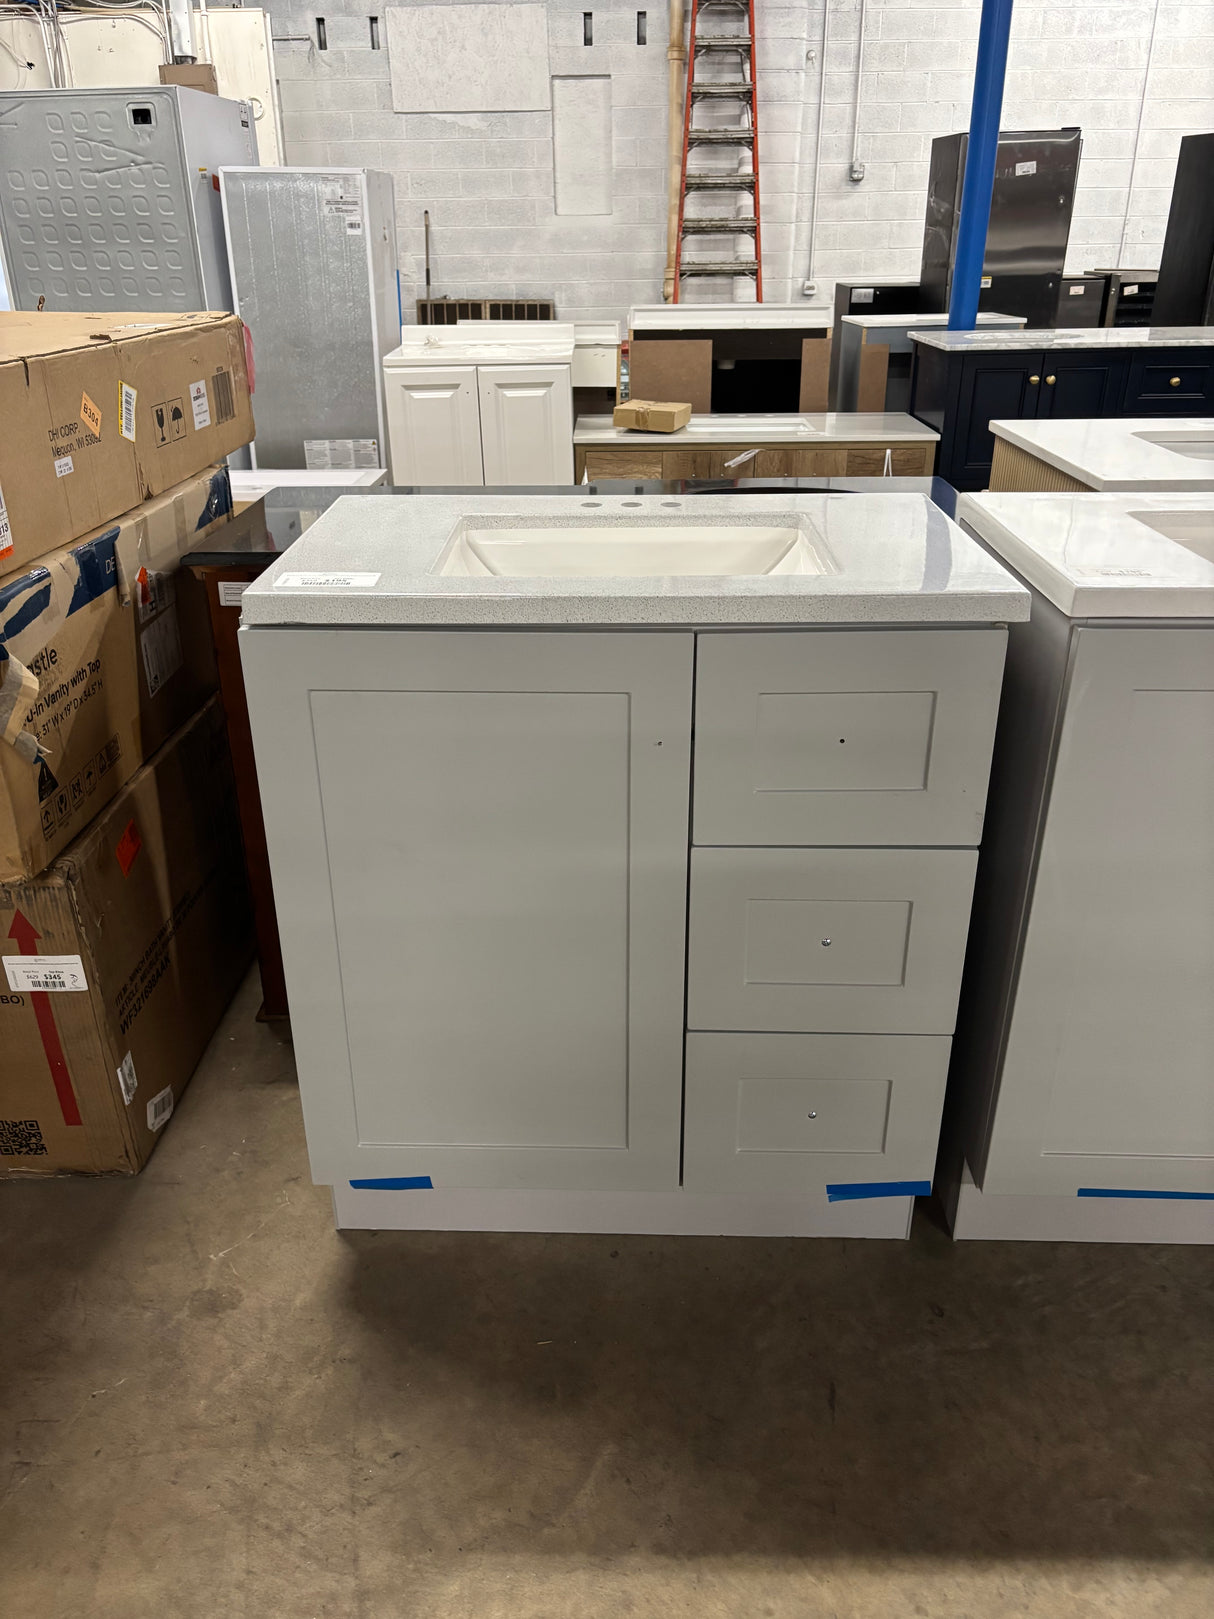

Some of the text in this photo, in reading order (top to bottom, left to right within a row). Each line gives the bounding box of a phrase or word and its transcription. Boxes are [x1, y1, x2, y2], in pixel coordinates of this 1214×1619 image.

[83, 403, 99, 427] B304
[48, 422, 80, 442] DHI CORP.
[51, 443, 77, 457] Mequon,
[76, 436, 86, 449] WI
[43, 680, 70, 708] Vanity
[70, 667, 88, 689] with
[87, 658, 101, 675] Top
[51, 713, 60, 729] W
[97, 678, 104, 690] H
